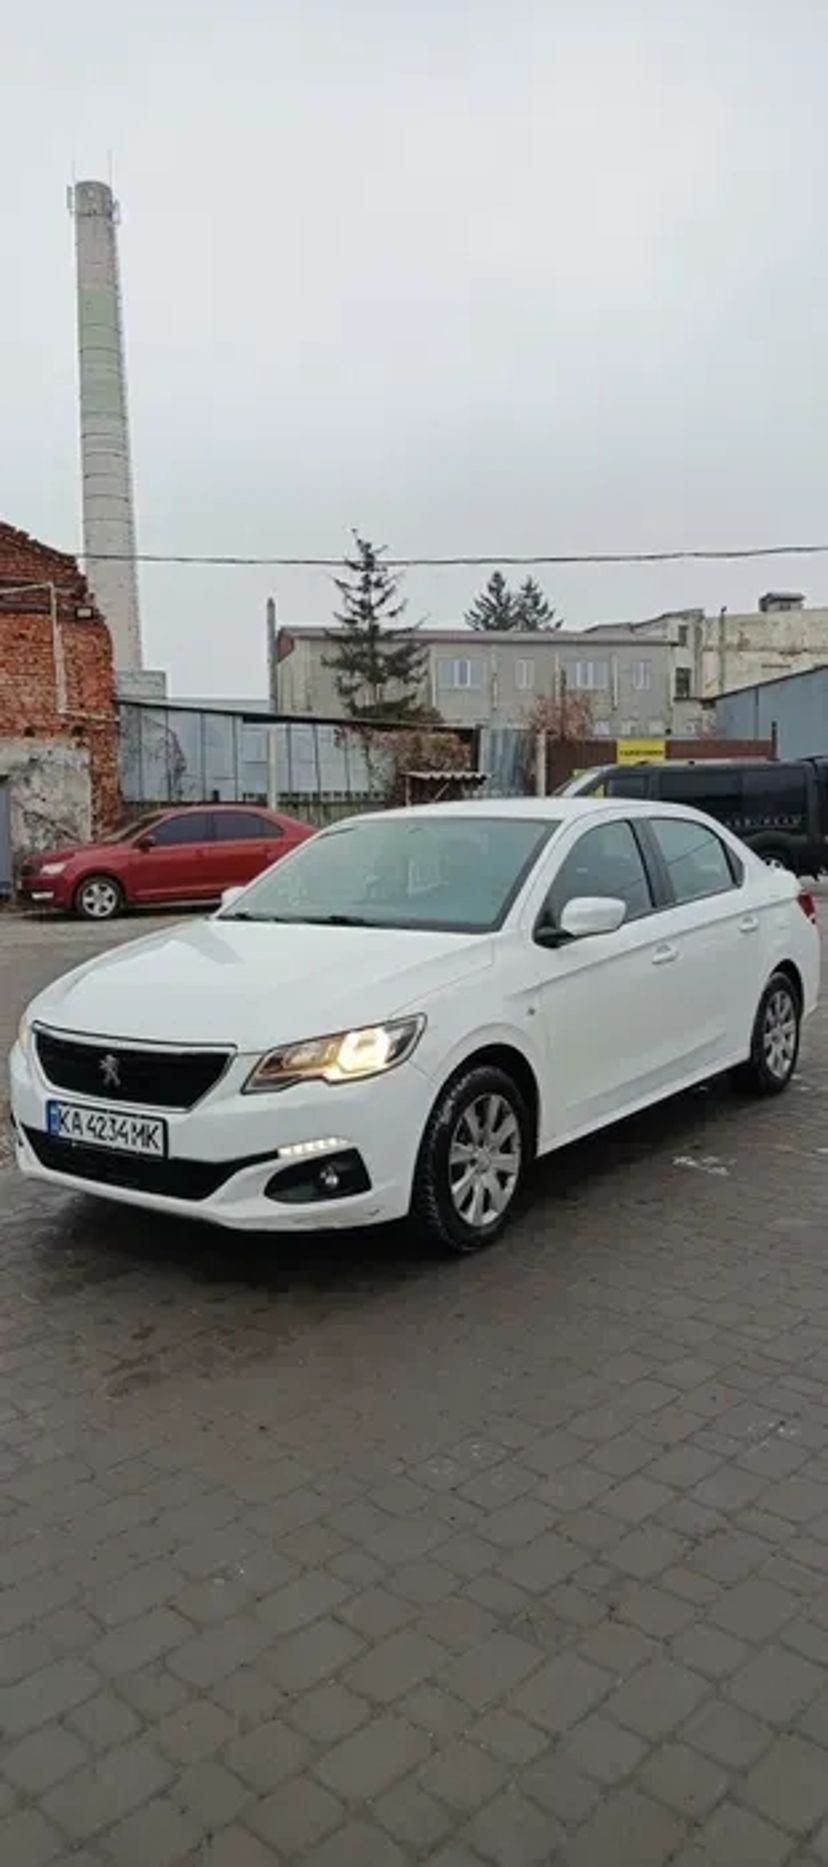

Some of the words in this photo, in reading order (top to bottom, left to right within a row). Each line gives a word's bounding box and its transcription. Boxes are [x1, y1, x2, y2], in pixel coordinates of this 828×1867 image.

[59, 1108, 83, 1136] KA
[86, 1113, 129, 1144] 4234
[131, 1121, 161, 1150] MK
